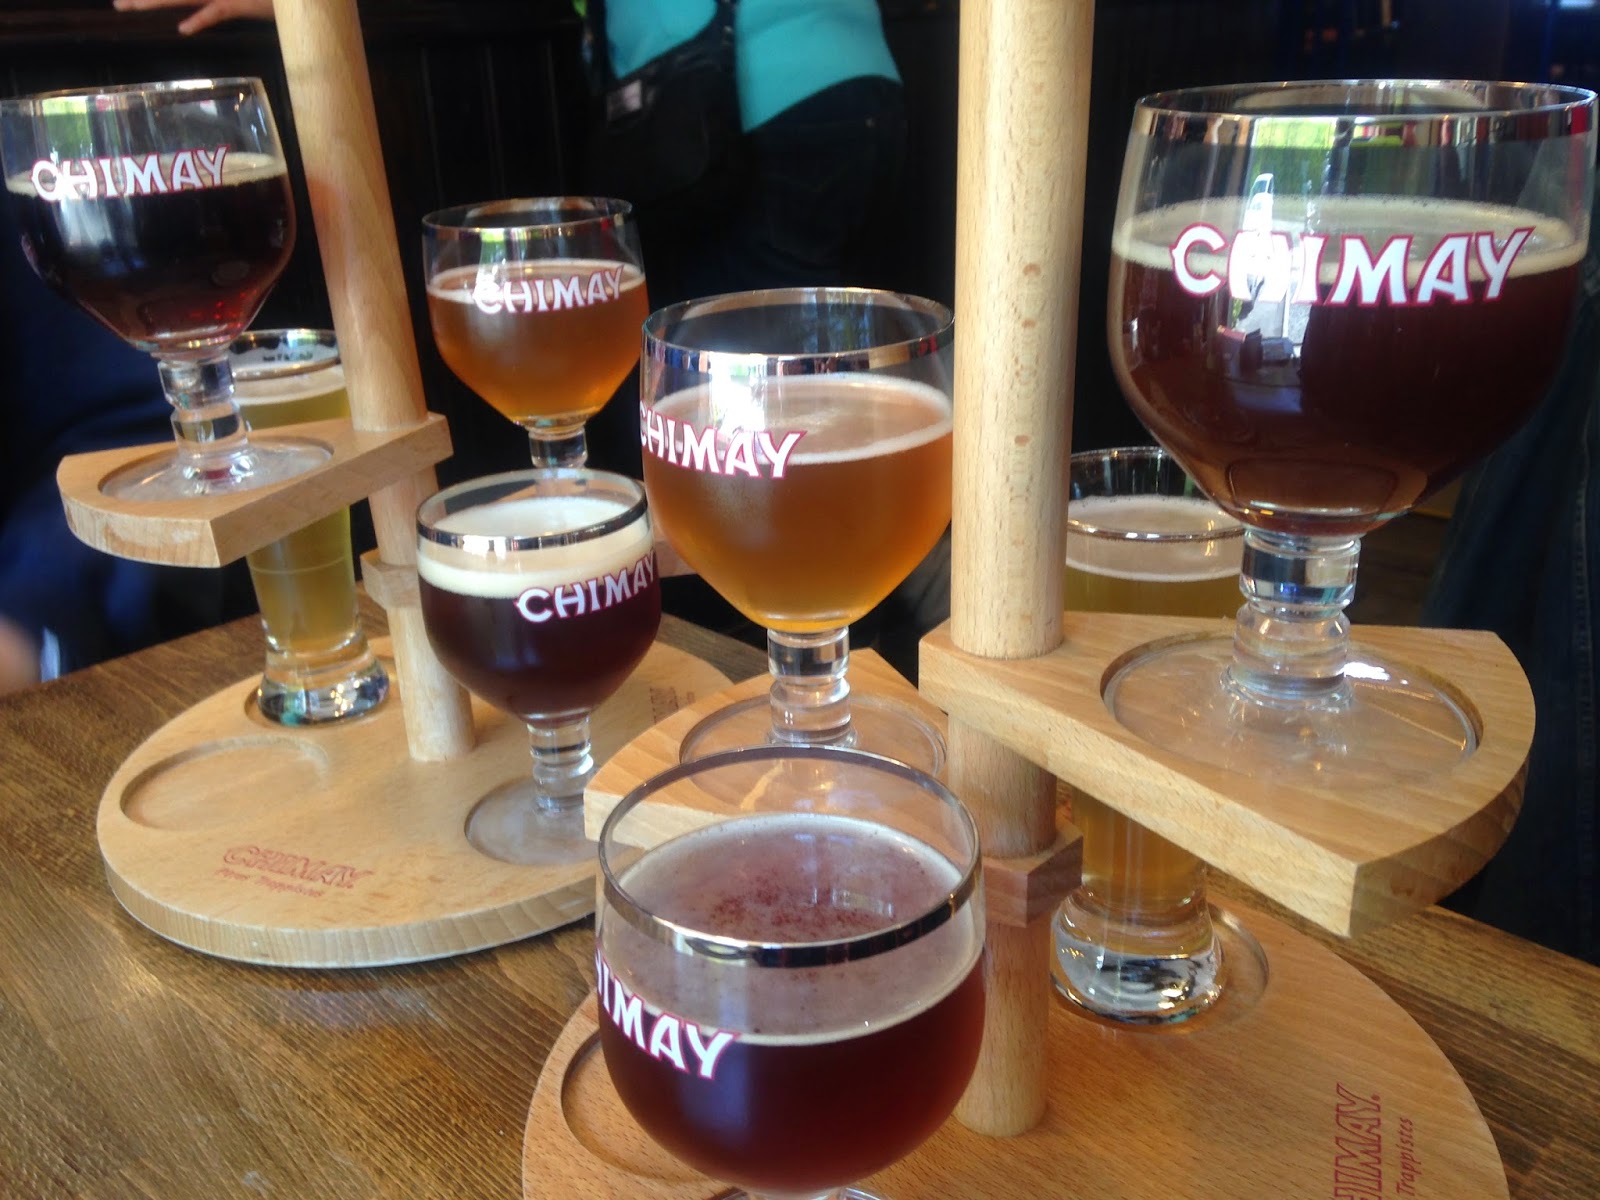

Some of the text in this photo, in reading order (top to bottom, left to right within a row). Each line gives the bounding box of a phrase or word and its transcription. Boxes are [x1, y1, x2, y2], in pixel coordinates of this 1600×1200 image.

[32, 144, 230, 201] CHIMAY
[472, 264, 625, 314] CHIMAY
[1169, 222, 1536, 307] CHIMAY
[513, 548, 655, 624] CHIMAY
[1395, 1116, 1422, 1197] Trappistes
